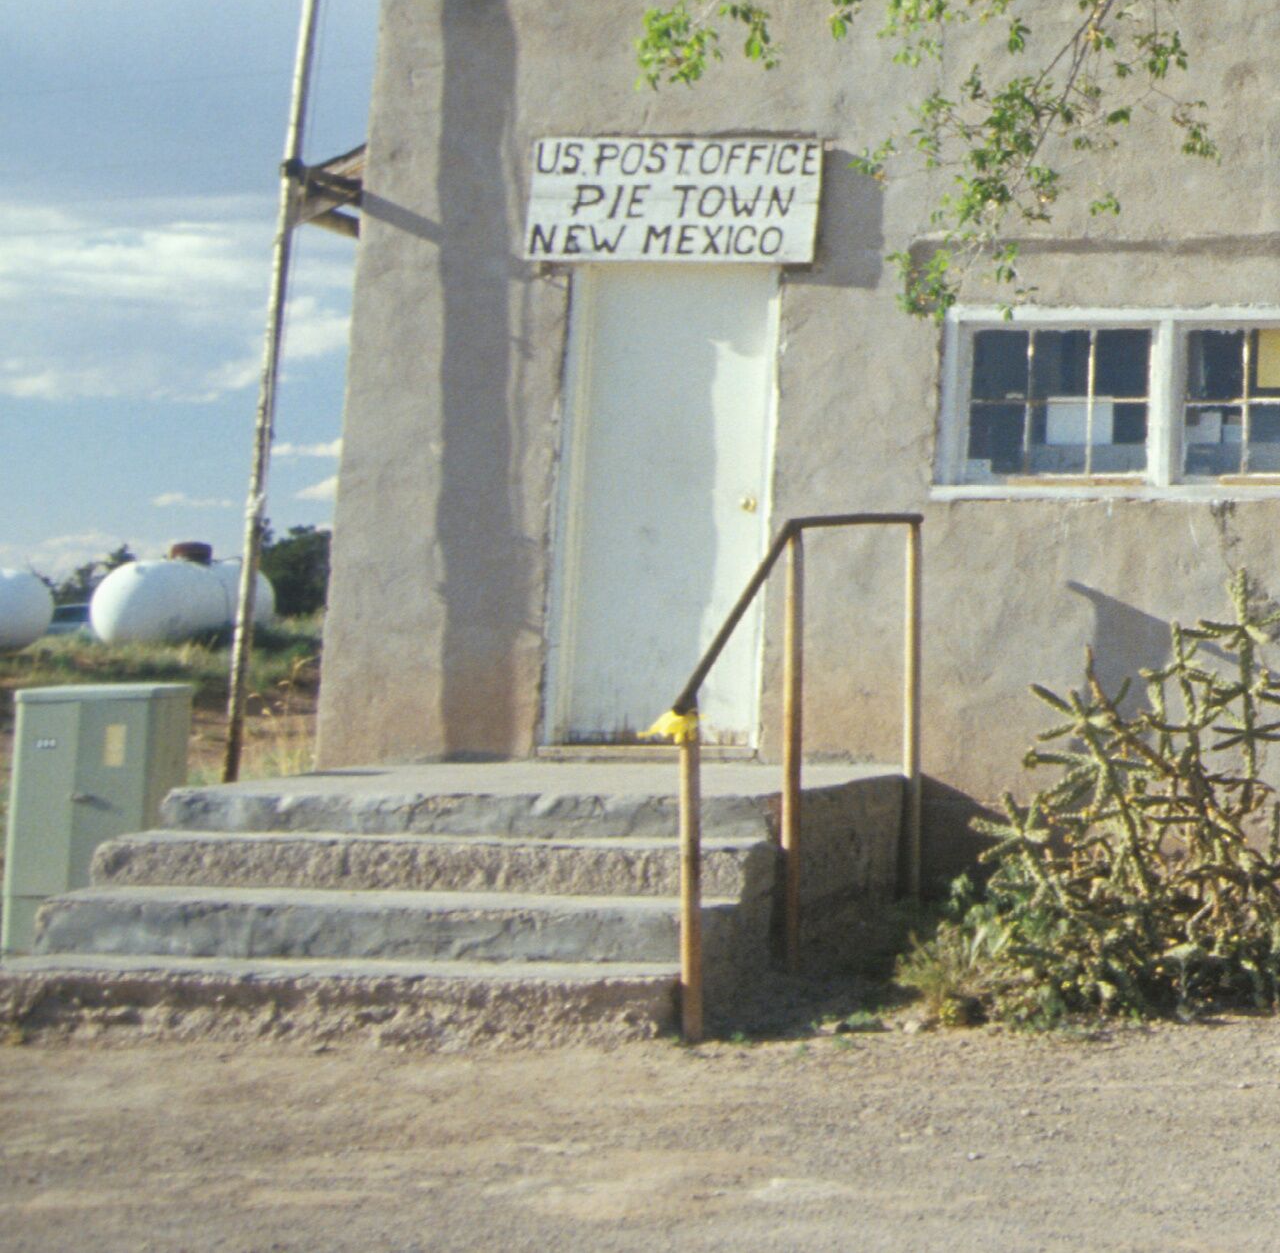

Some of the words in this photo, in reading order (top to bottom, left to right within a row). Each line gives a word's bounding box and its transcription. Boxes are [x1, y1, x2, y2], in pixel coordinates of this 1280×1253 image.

[594, 142, 696, 176] POST
[699, 142, 820, 176] OFFICE
[572, 184, 651, 219] PIE
[673, 185, 796, 218] TOWN
[529, 224, 626, 254] NEW
[642, 225, 784, 255] MEXICO
